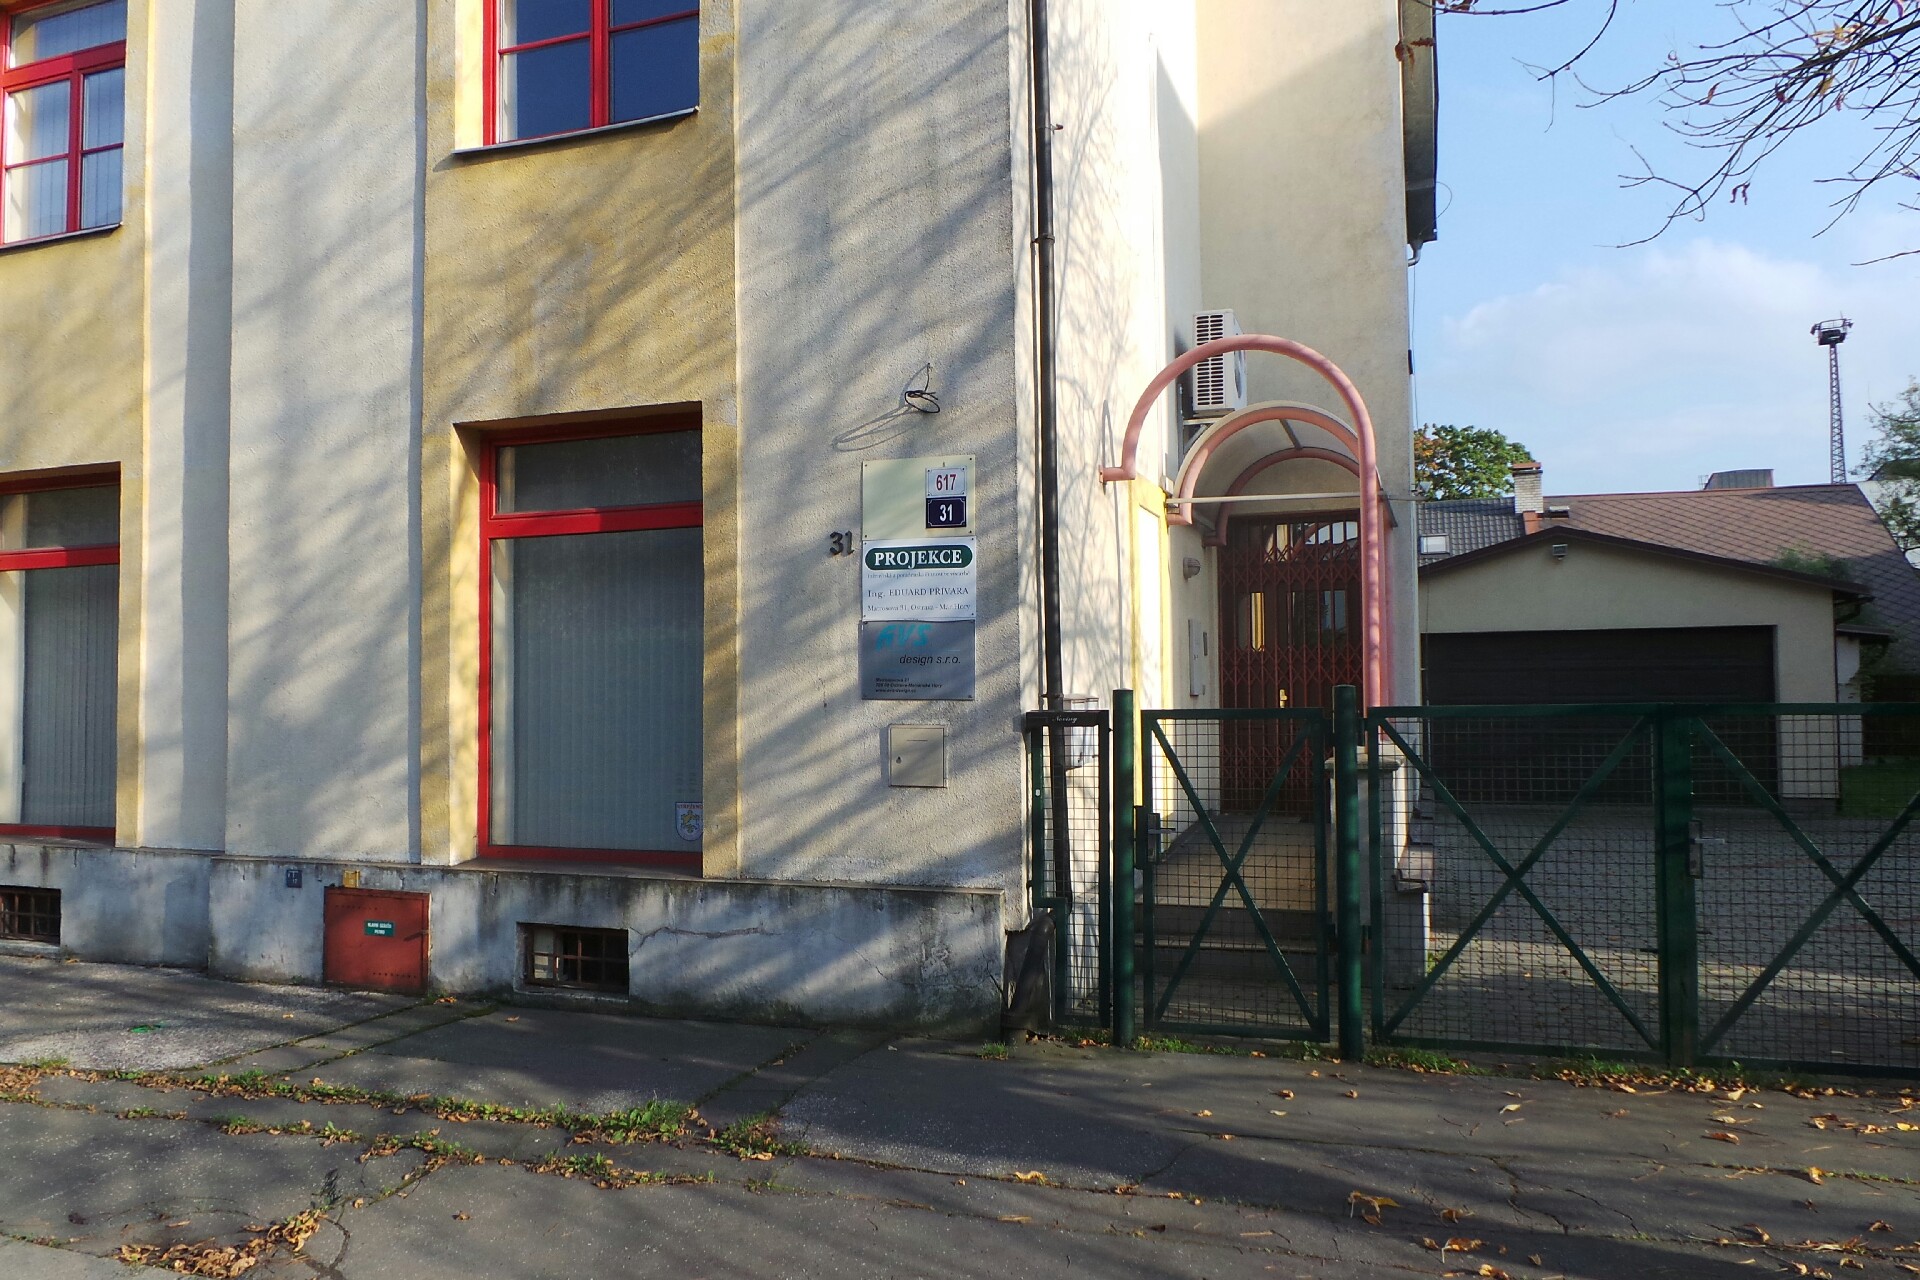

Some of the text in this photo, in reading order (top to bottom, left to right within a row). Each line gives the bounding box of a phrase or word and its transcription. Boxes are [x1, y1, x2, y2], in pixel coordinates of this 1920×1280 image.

[936, 473, 956, 491] 617
[939, 503, 953, 522] 31
[829, 530, 854, 557] 31
[874, 549, 963, 569] PROJEKCE
[868, 590, 886, 600] Ing.
[889, 588, 927, 597] EDUARD
[899, 654, 961, 666] design s.r.o.
